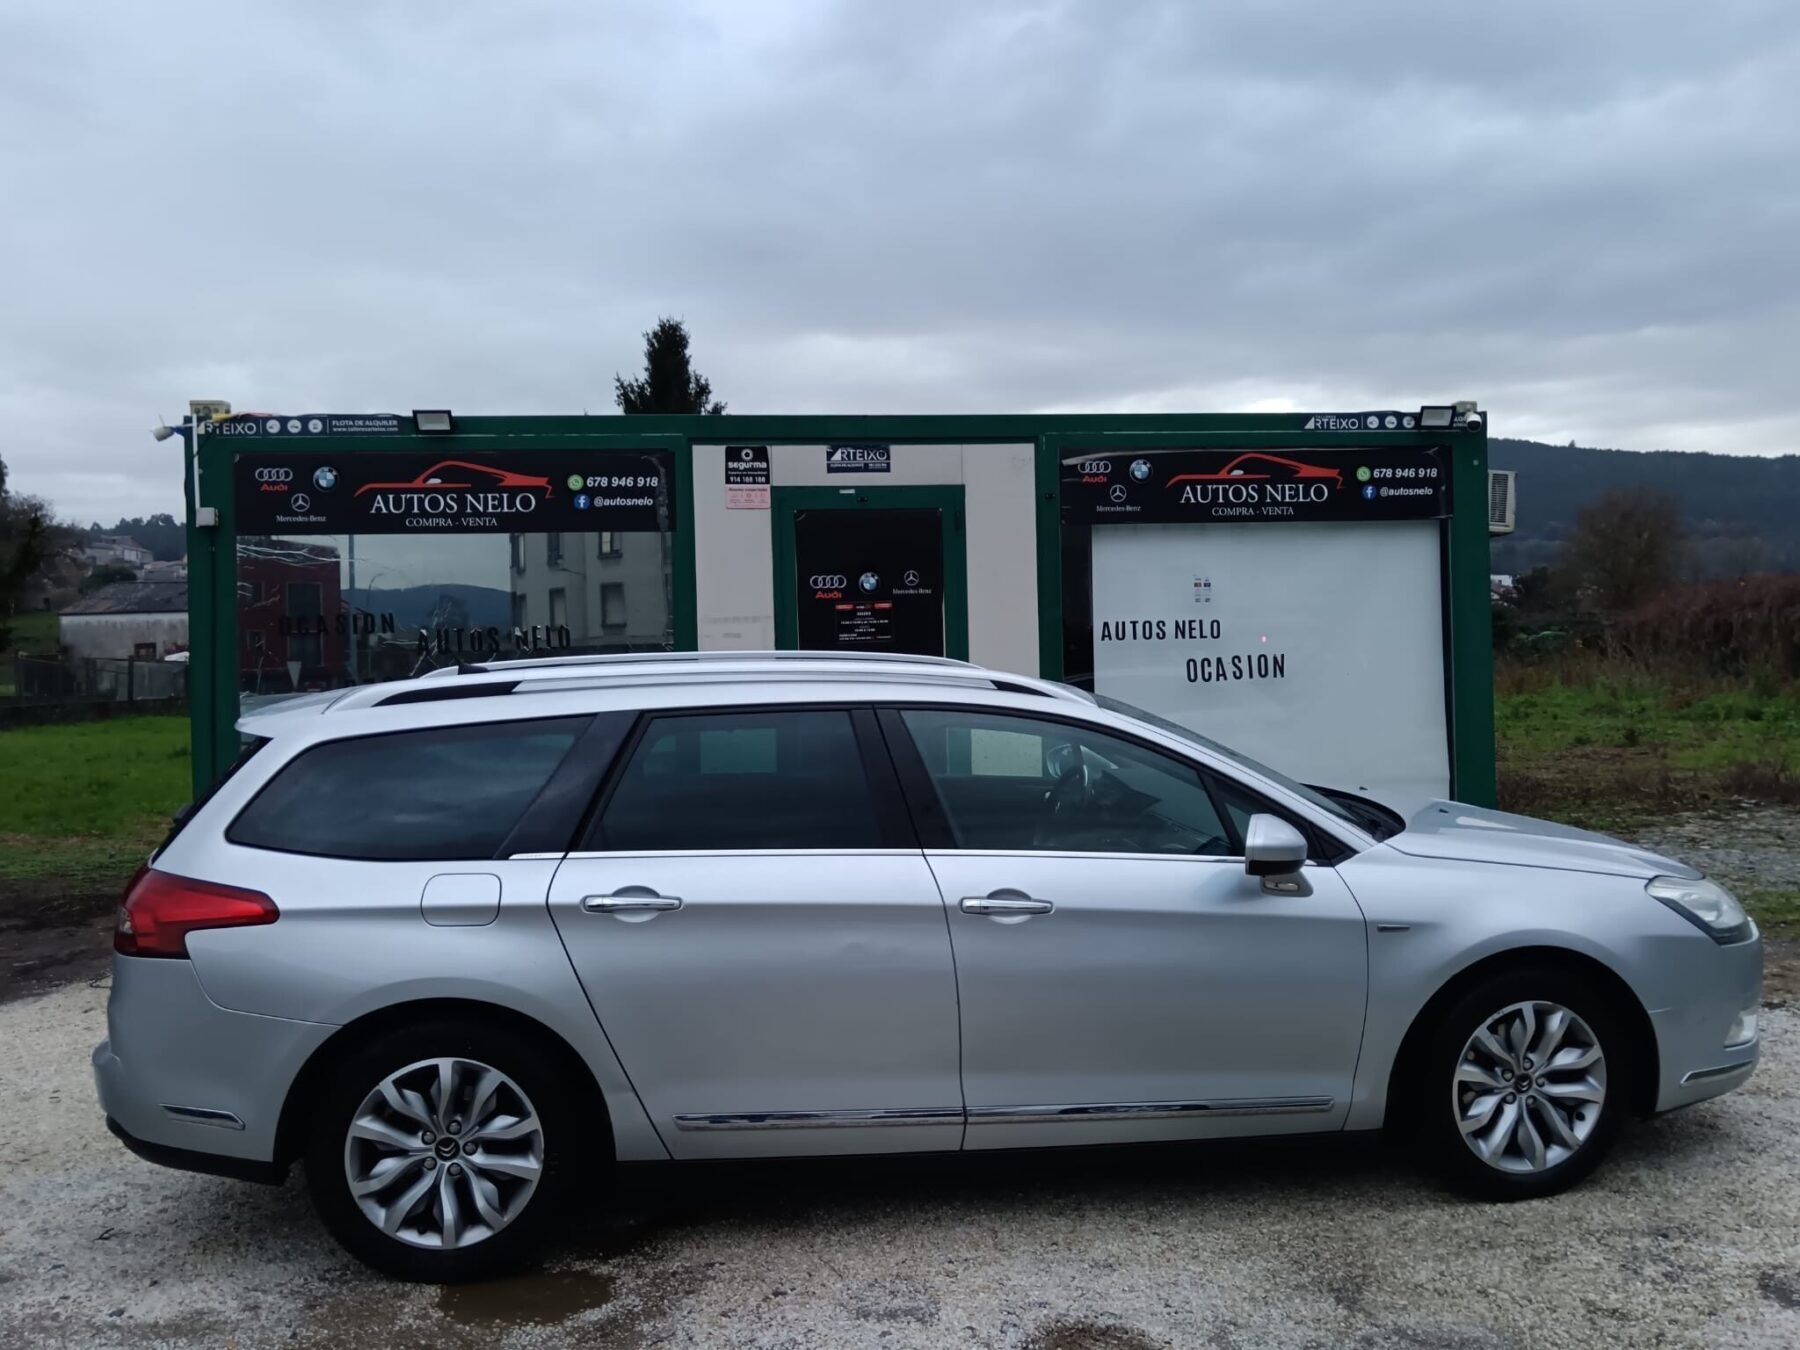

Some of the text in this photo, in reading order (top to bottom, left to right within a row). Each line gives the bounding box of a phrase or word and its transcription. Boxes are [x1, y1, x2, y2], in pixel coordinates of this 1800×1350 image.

[728, 461, 767, 470] segurma
[1373, 468, 1438, 478] 678 946 918
[587, 475, 659, 488] 678 946 918
[1180, 483, 1329, 504] AUTOS NELO
[1380, 486, 1433, 497] @autosnelo
[369, 492, 537, 514] AUTOS NELO
[593, 495, 654, 507] @autosnelo
[1096, 504, 1141, 513] Mercedes-Benz
[1212, 506, 1255, 517] COMPRA
[1261, 505, 1294, 516] VENTA
[276, 514, 327, 522] Mercedes-Benz
[405, 516, 454, 528] COMPRA
[461, 516, 498, 527] VENTA
[815, 590, 843, 599] Audi
[279, 611, 396, 636] OCASION
[1100, 618, 1221, 642] AUTOS NELO
[417, 625, 500, 655] AUTOS
[1186, 653, 1286, 683] OCASION
